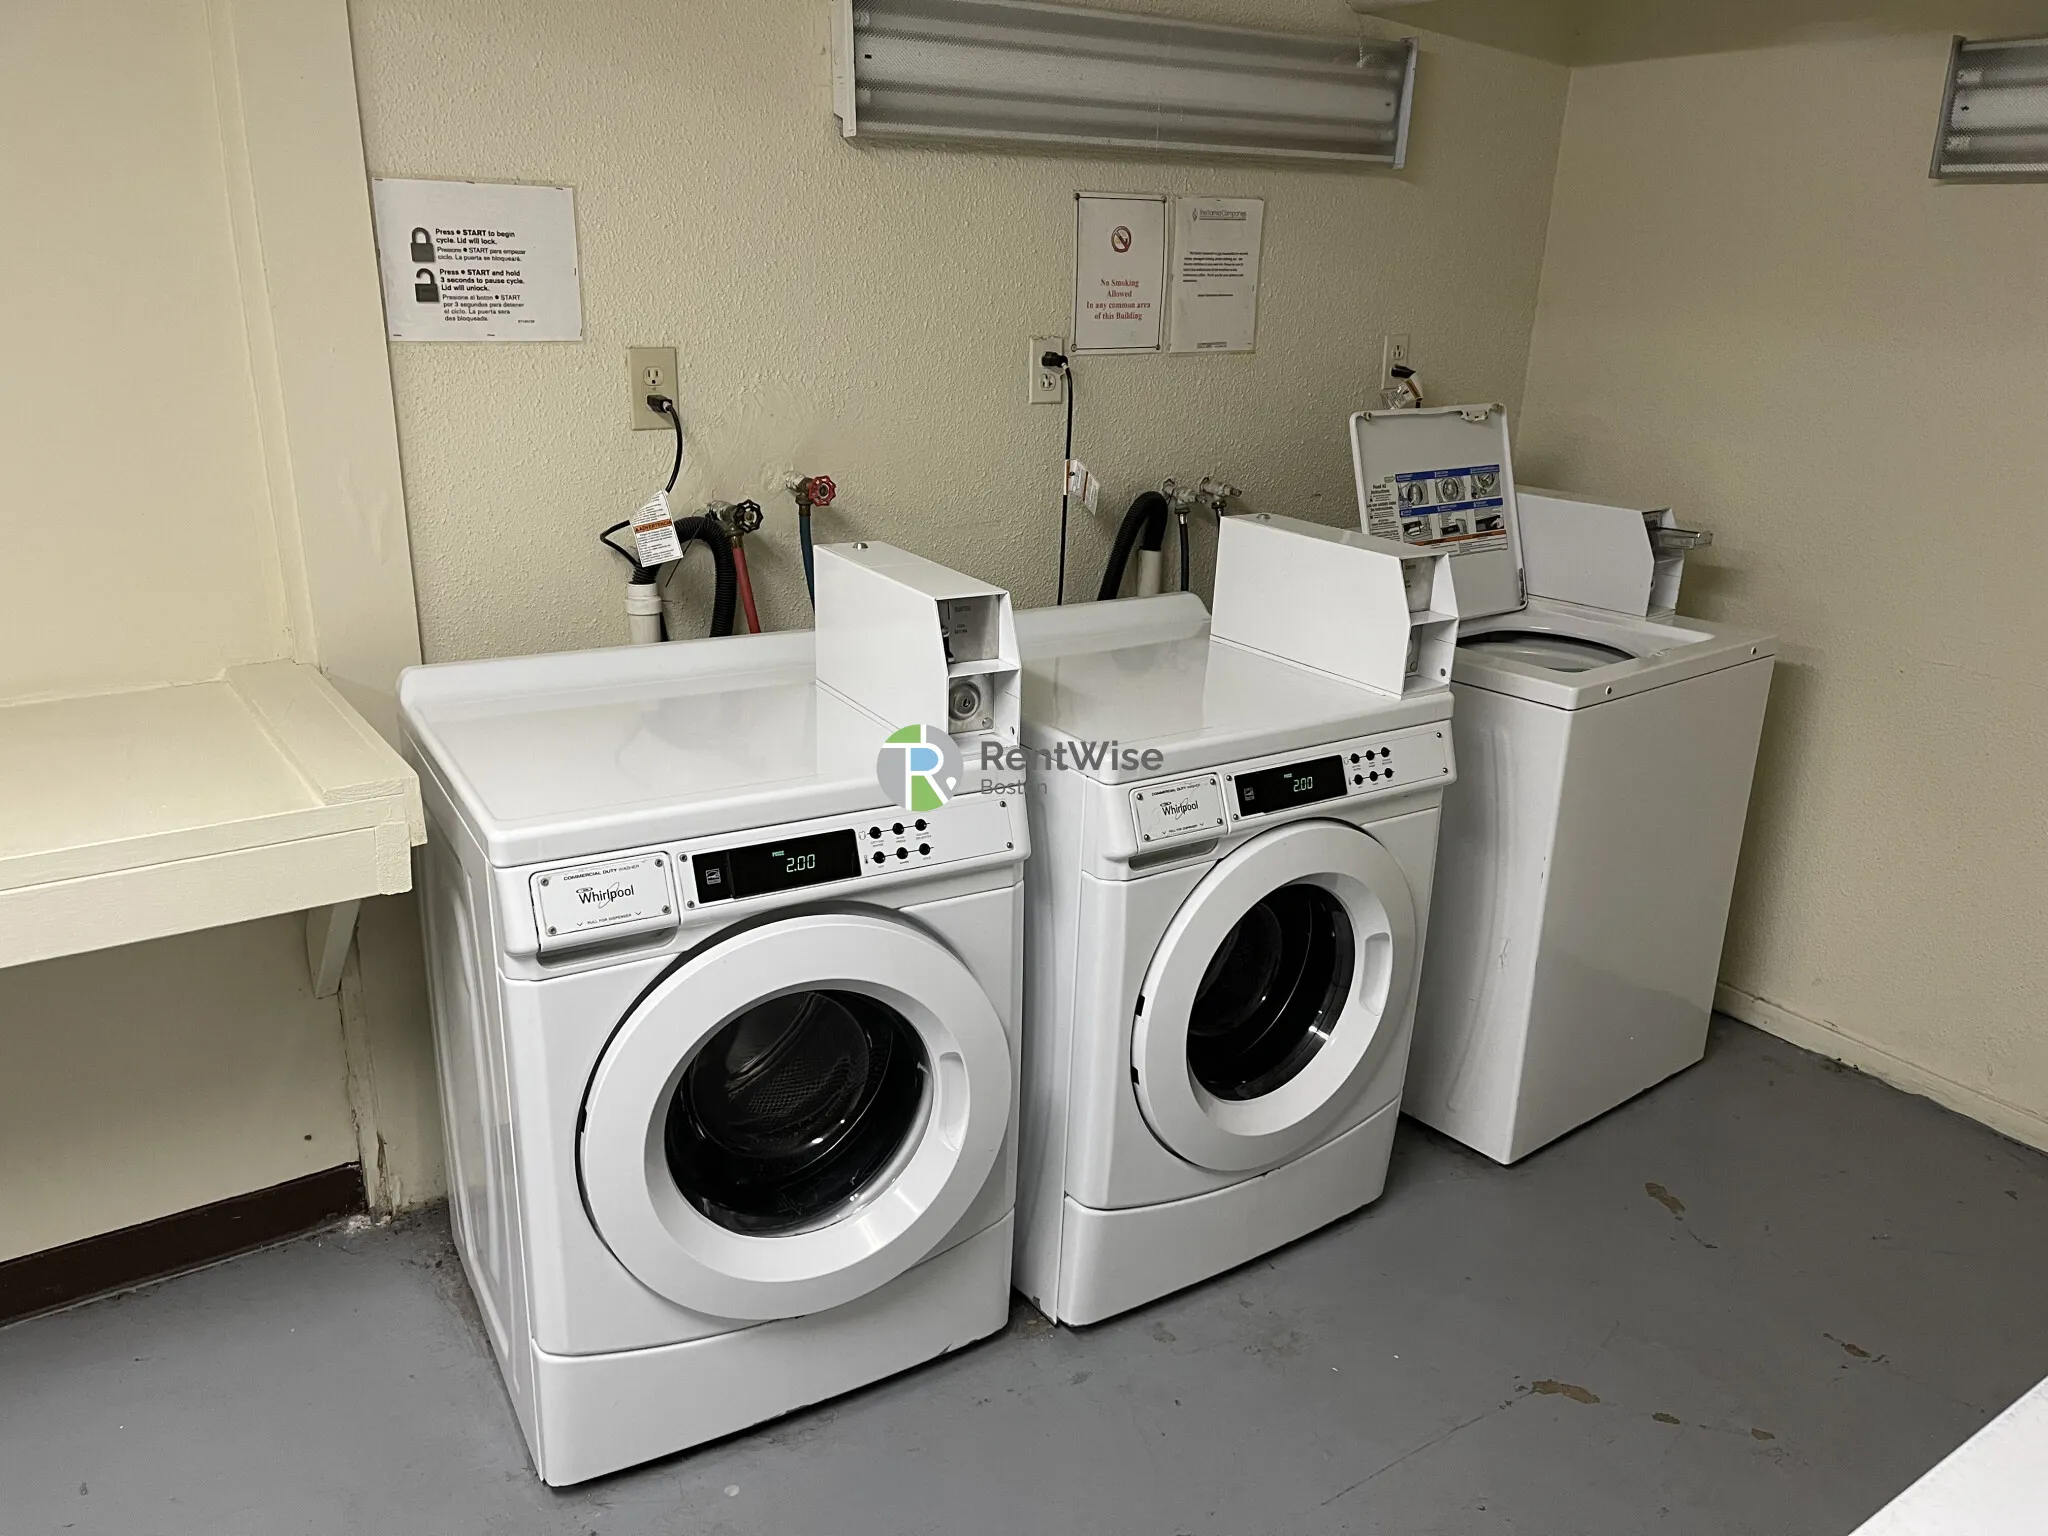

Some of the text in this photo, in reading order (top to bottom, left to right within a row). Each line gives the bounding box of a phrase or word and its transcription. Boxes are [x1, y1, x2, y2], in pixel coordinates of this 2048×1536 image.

[496, 230, 516, 238] begin
[1111, 279, 1140, 288] Smoking
[1116, 312, 1142, 320] Building
[1294, 776, 1313, 792] 2.00
[1162, 800, 1198, 816] Whirlpool
[786, 854, 815, 872] 2.00
[564, 871, 602, 880] COMMERCIAL
[578, 885, 634, 904] Whirlpool
